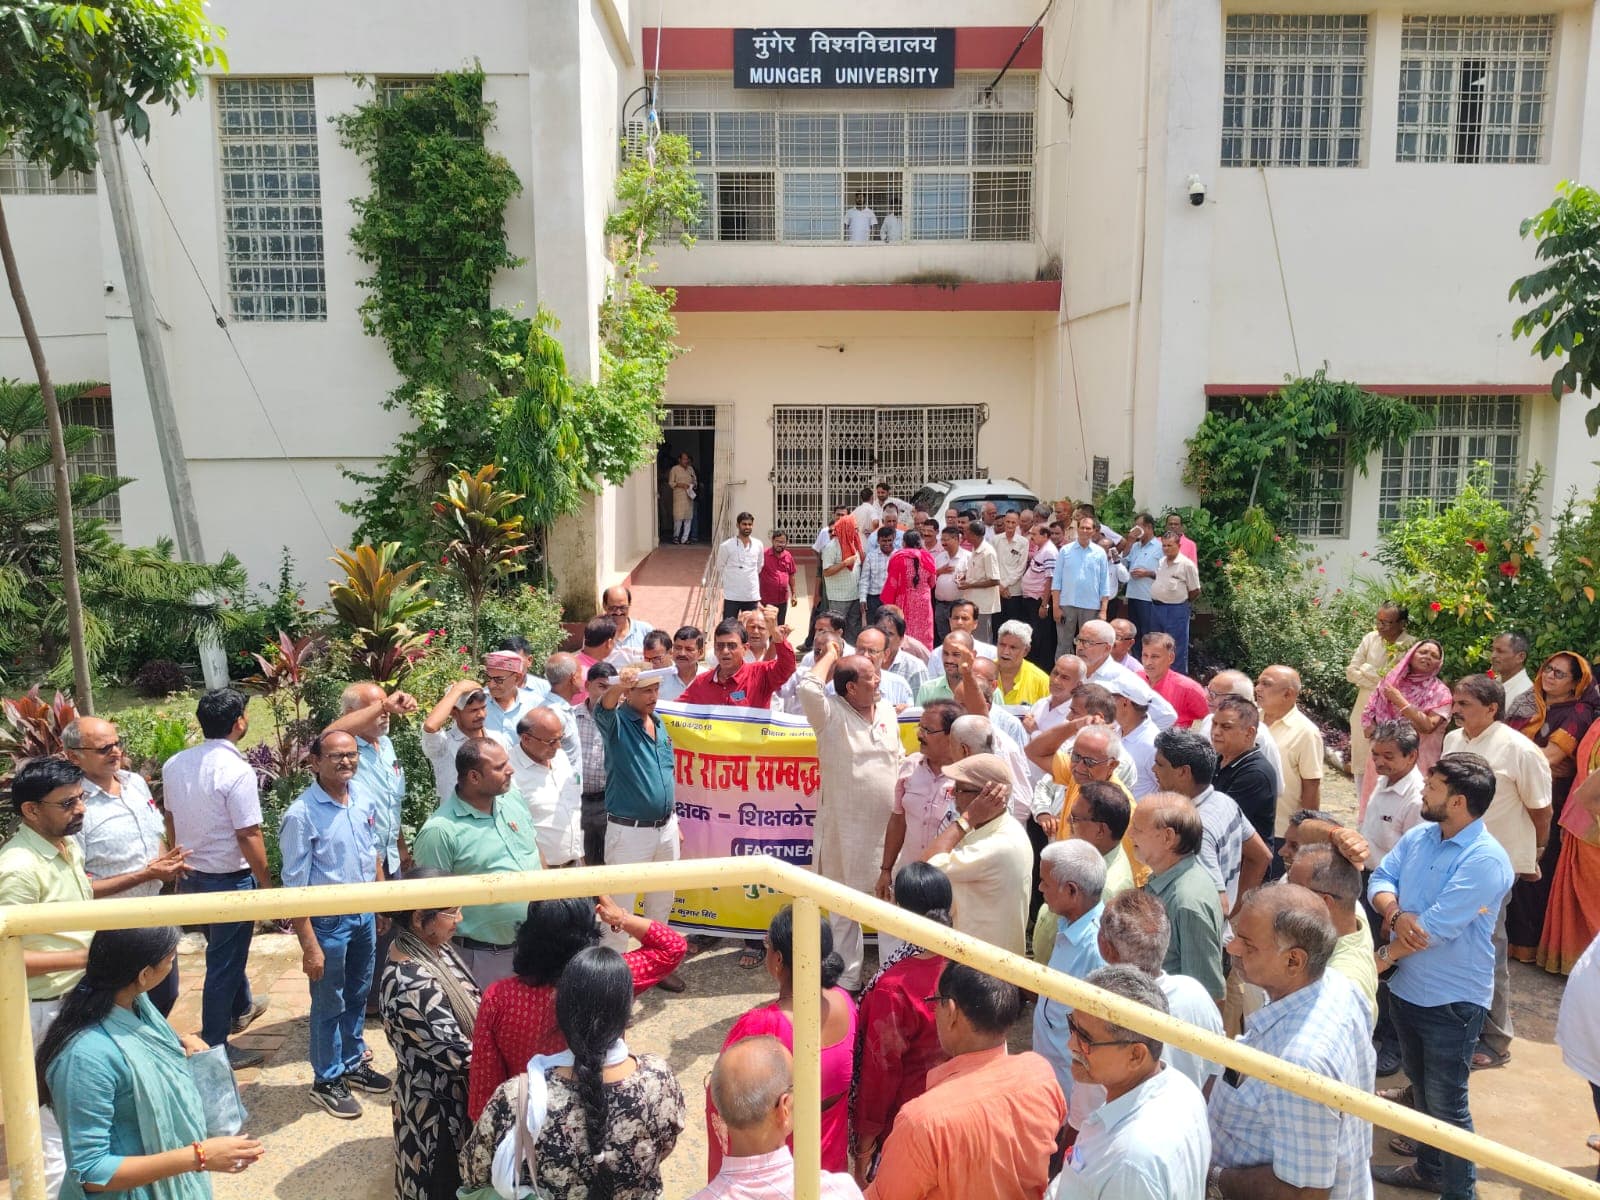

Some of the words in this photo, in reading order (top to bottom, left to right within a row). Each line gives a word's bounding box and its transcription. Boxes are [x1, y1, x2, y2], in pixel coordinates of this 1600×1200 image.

[752, 31, 796, 59] मुंगेर
[809, 31, 937, 53] विश्वविद्यालय
[750, 67, 822, 84] MUNGER
[835, 67, 939, 84] UNIVERSITY
[698, 753, 751, 791] राज्य
